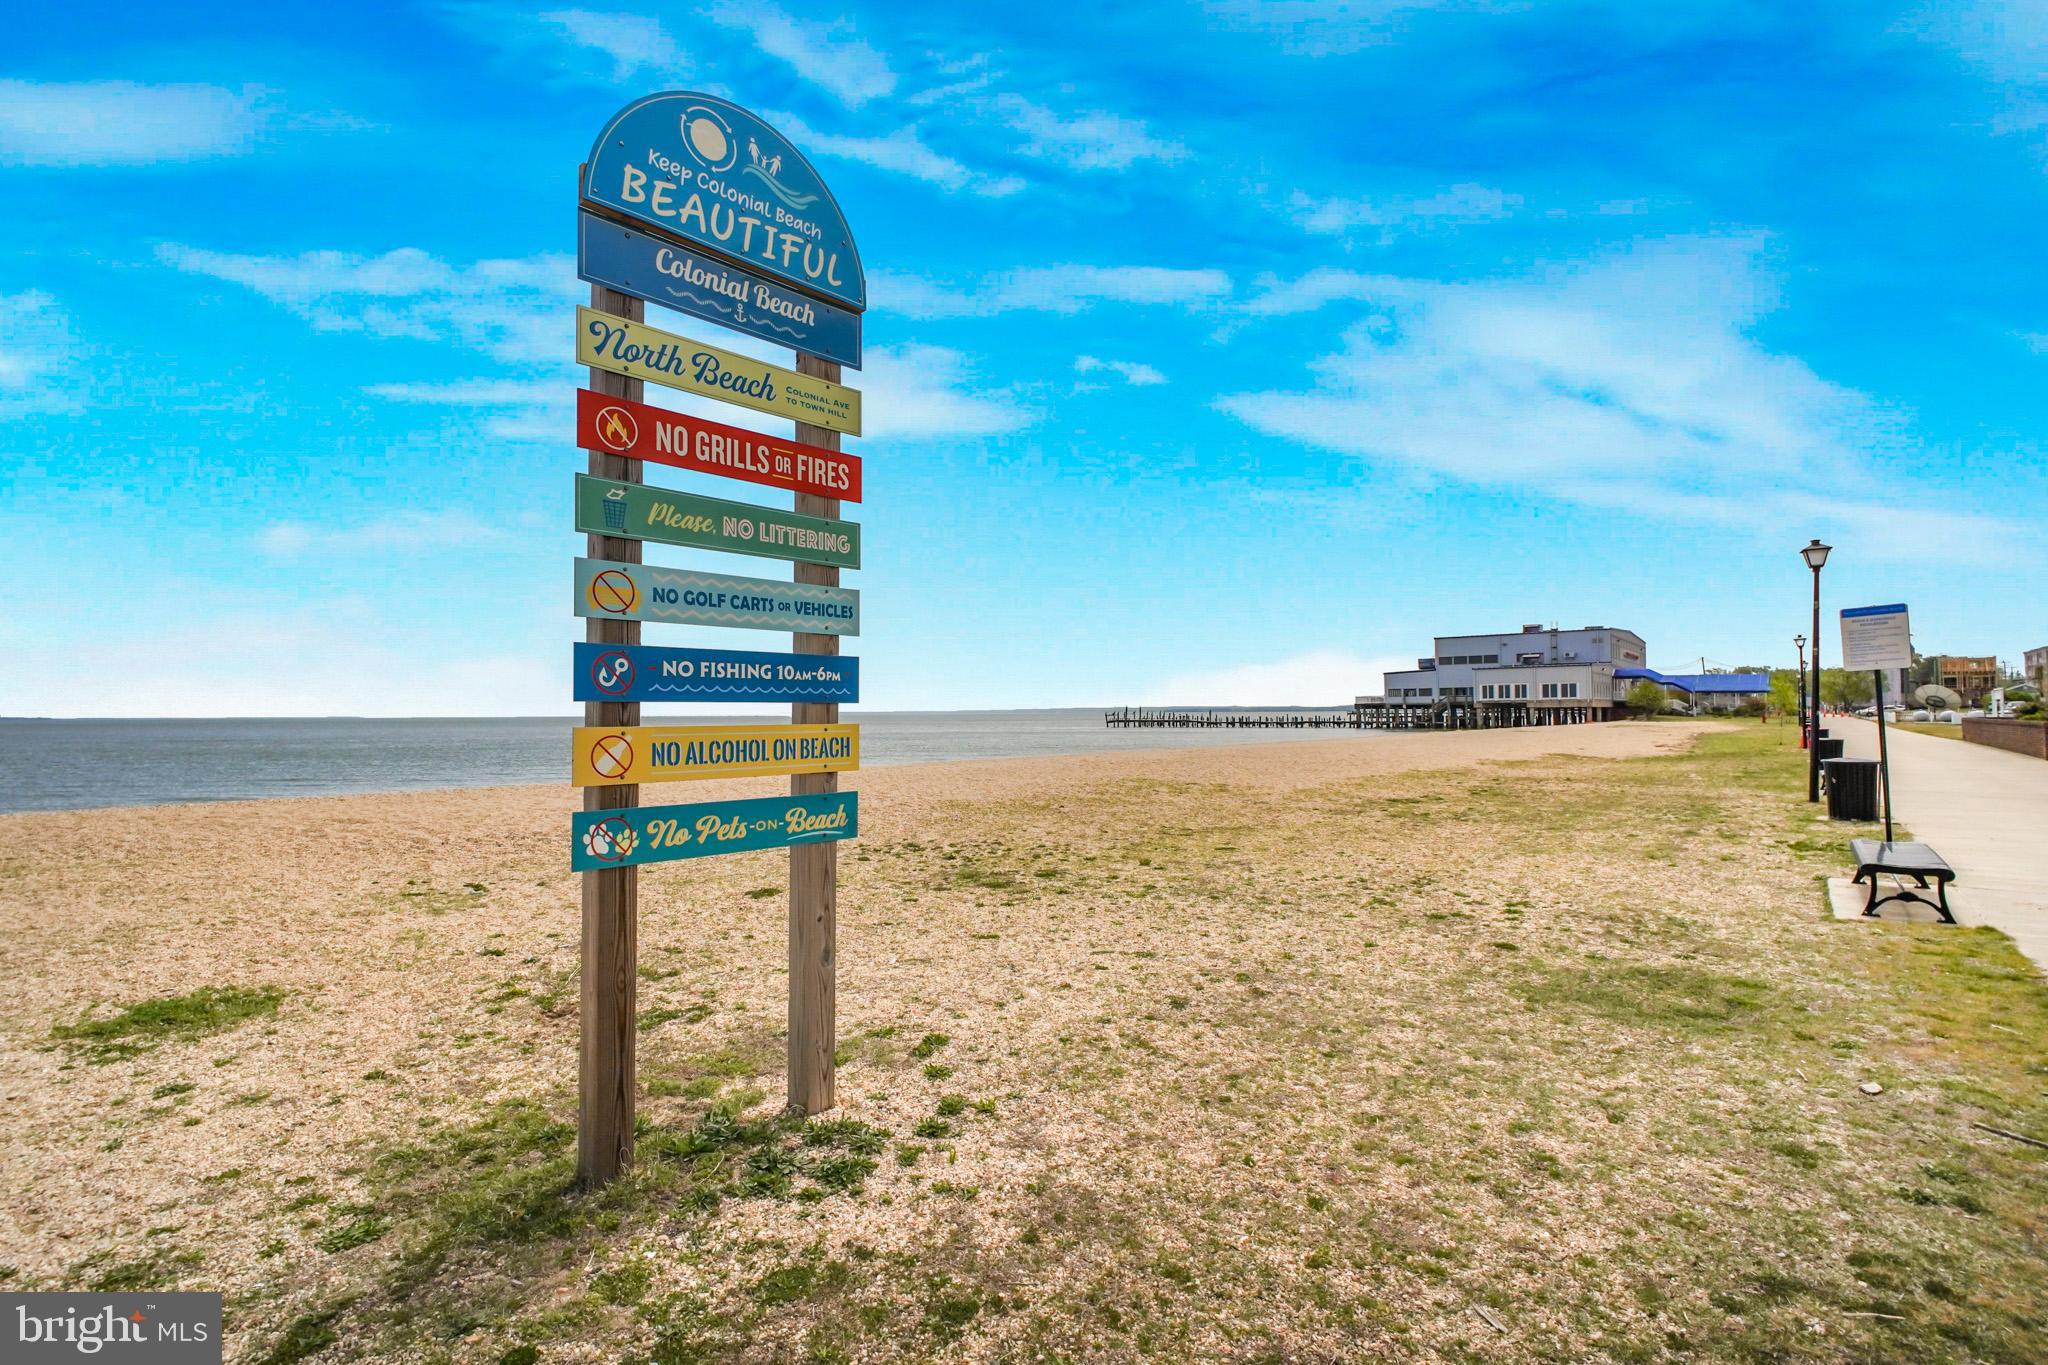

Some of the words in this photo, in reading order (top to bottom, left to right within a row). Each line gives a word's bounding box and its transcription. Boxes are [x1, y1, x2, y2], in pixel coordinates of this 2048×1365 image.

[649, 149, 692, 185] Keep
[697, 172, 771, 218] Colonial
[776, 206, 822, 240] Beach
[621, 163, 842, 287] BEAUTIFUL
[655, 248, 749, 302] Colonial
[754, 284, 815, 327] Beach
[589, 320, 686, 376] North
[692, 352, 776, 401] Beach
[785, 396, 798, 406] TO
[799, 400, 825, 414] TOWN
[827, 408, 848, 419] HILL
[656, 421, 689, 457] NO
[695, 431, 770, 474] GRILLS
[775, 455, 792, 475] OR
[797, 455, 850, 491] FIRES
[723, 516, 754, 540] NO
[760, 522, 850, 554] LITTERING
[652, 586, 679, 605] NO
[683, 590, 726, 608] GOLF
[730, 594, 775, 613] CARTS
[777, 601, 791, 612] OR
[794, 600, 854, 620] VEHICLES
[662, 660, 694, 677] NO
[700, 661, 773, 680] FISHING
[651, 742, 681, 766] NO
[685, 739, 770, 765] ALCOHOL
[773, 738, 797, 760] ON
[799, 736, 851, 760] BEACH
[646, 818, 693, 850] No
[695, 815, 747, 843] Pets
[785, 803, 848, 833] Beach
